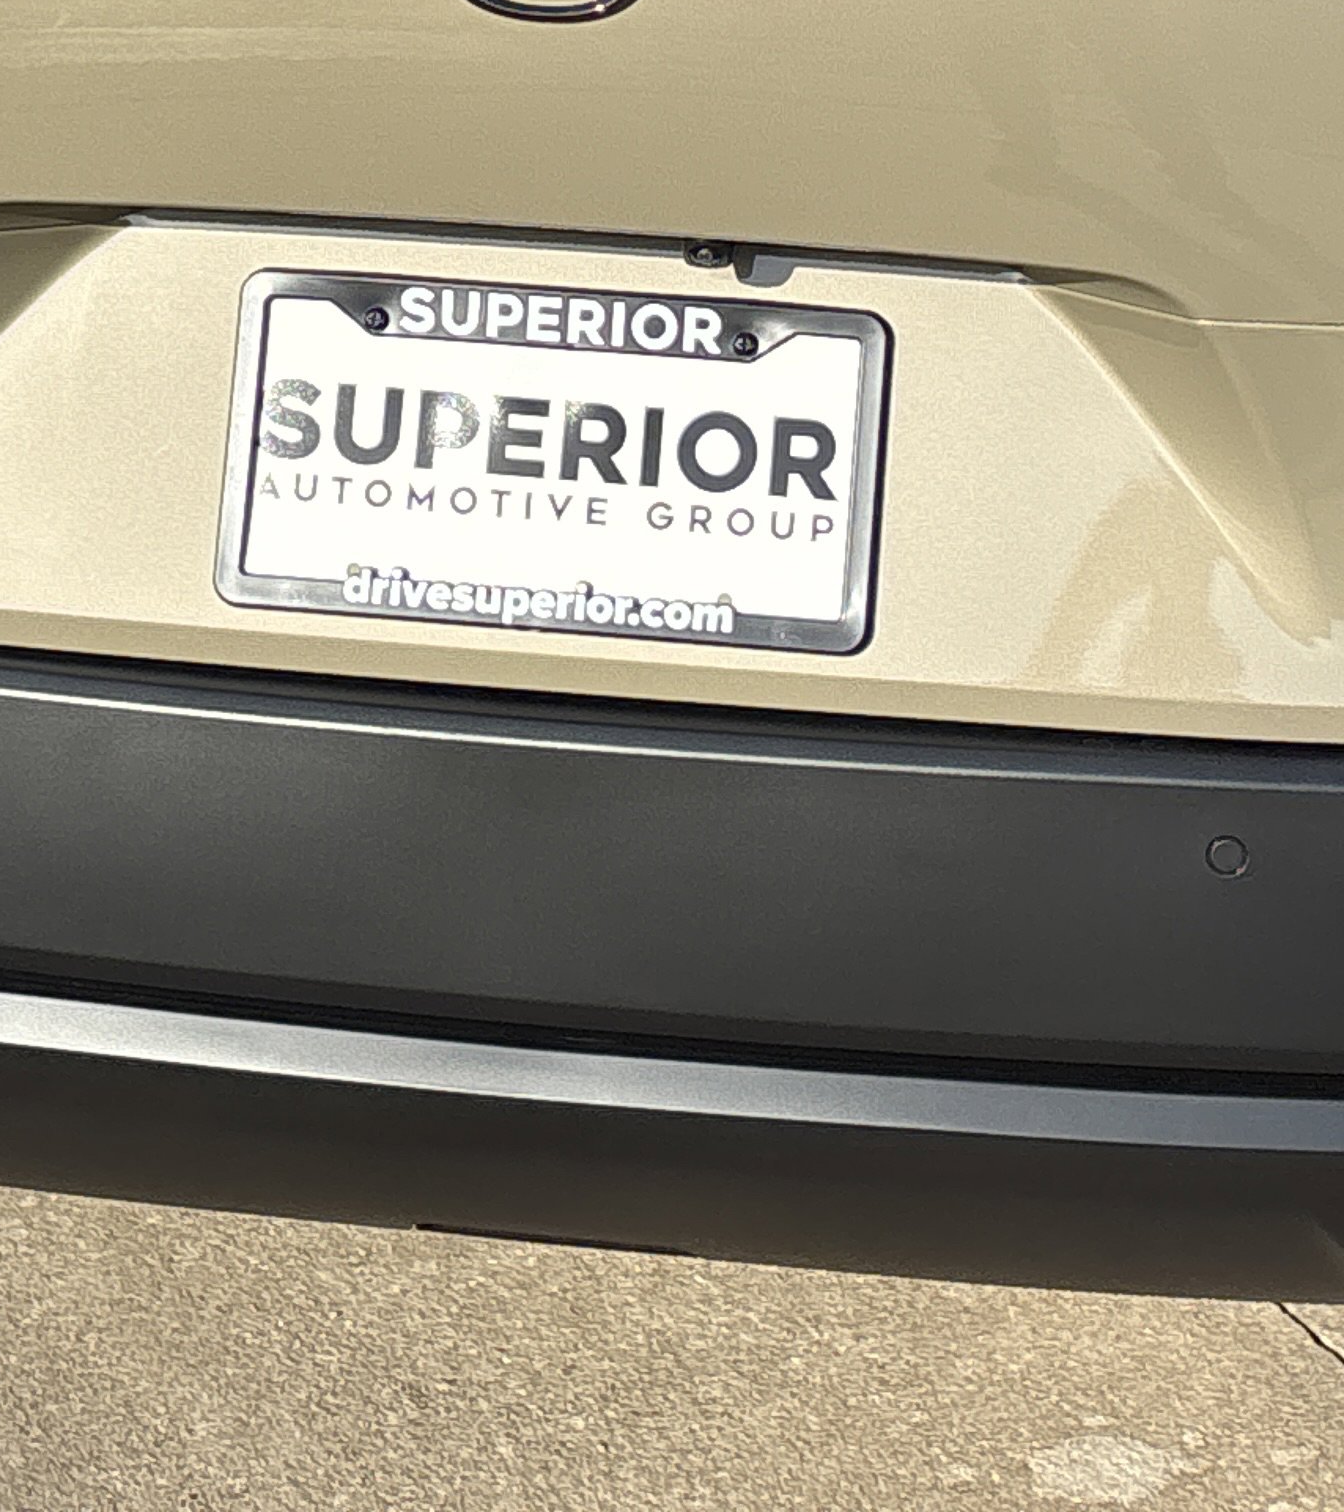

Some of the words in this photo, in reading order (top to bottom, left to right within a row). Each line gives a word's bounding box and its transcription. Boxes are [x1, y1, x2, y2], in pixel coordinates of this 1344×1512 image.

[398, 285, 724, 357] SUPERIOR
[258, 377, 838, 502] SUPERIOR
[259, 472, 608, 526] AUTOMOTIVE
[646, 502, 835, 542] GROUP
[342, 564, 735, 634] drivesuperior.com
